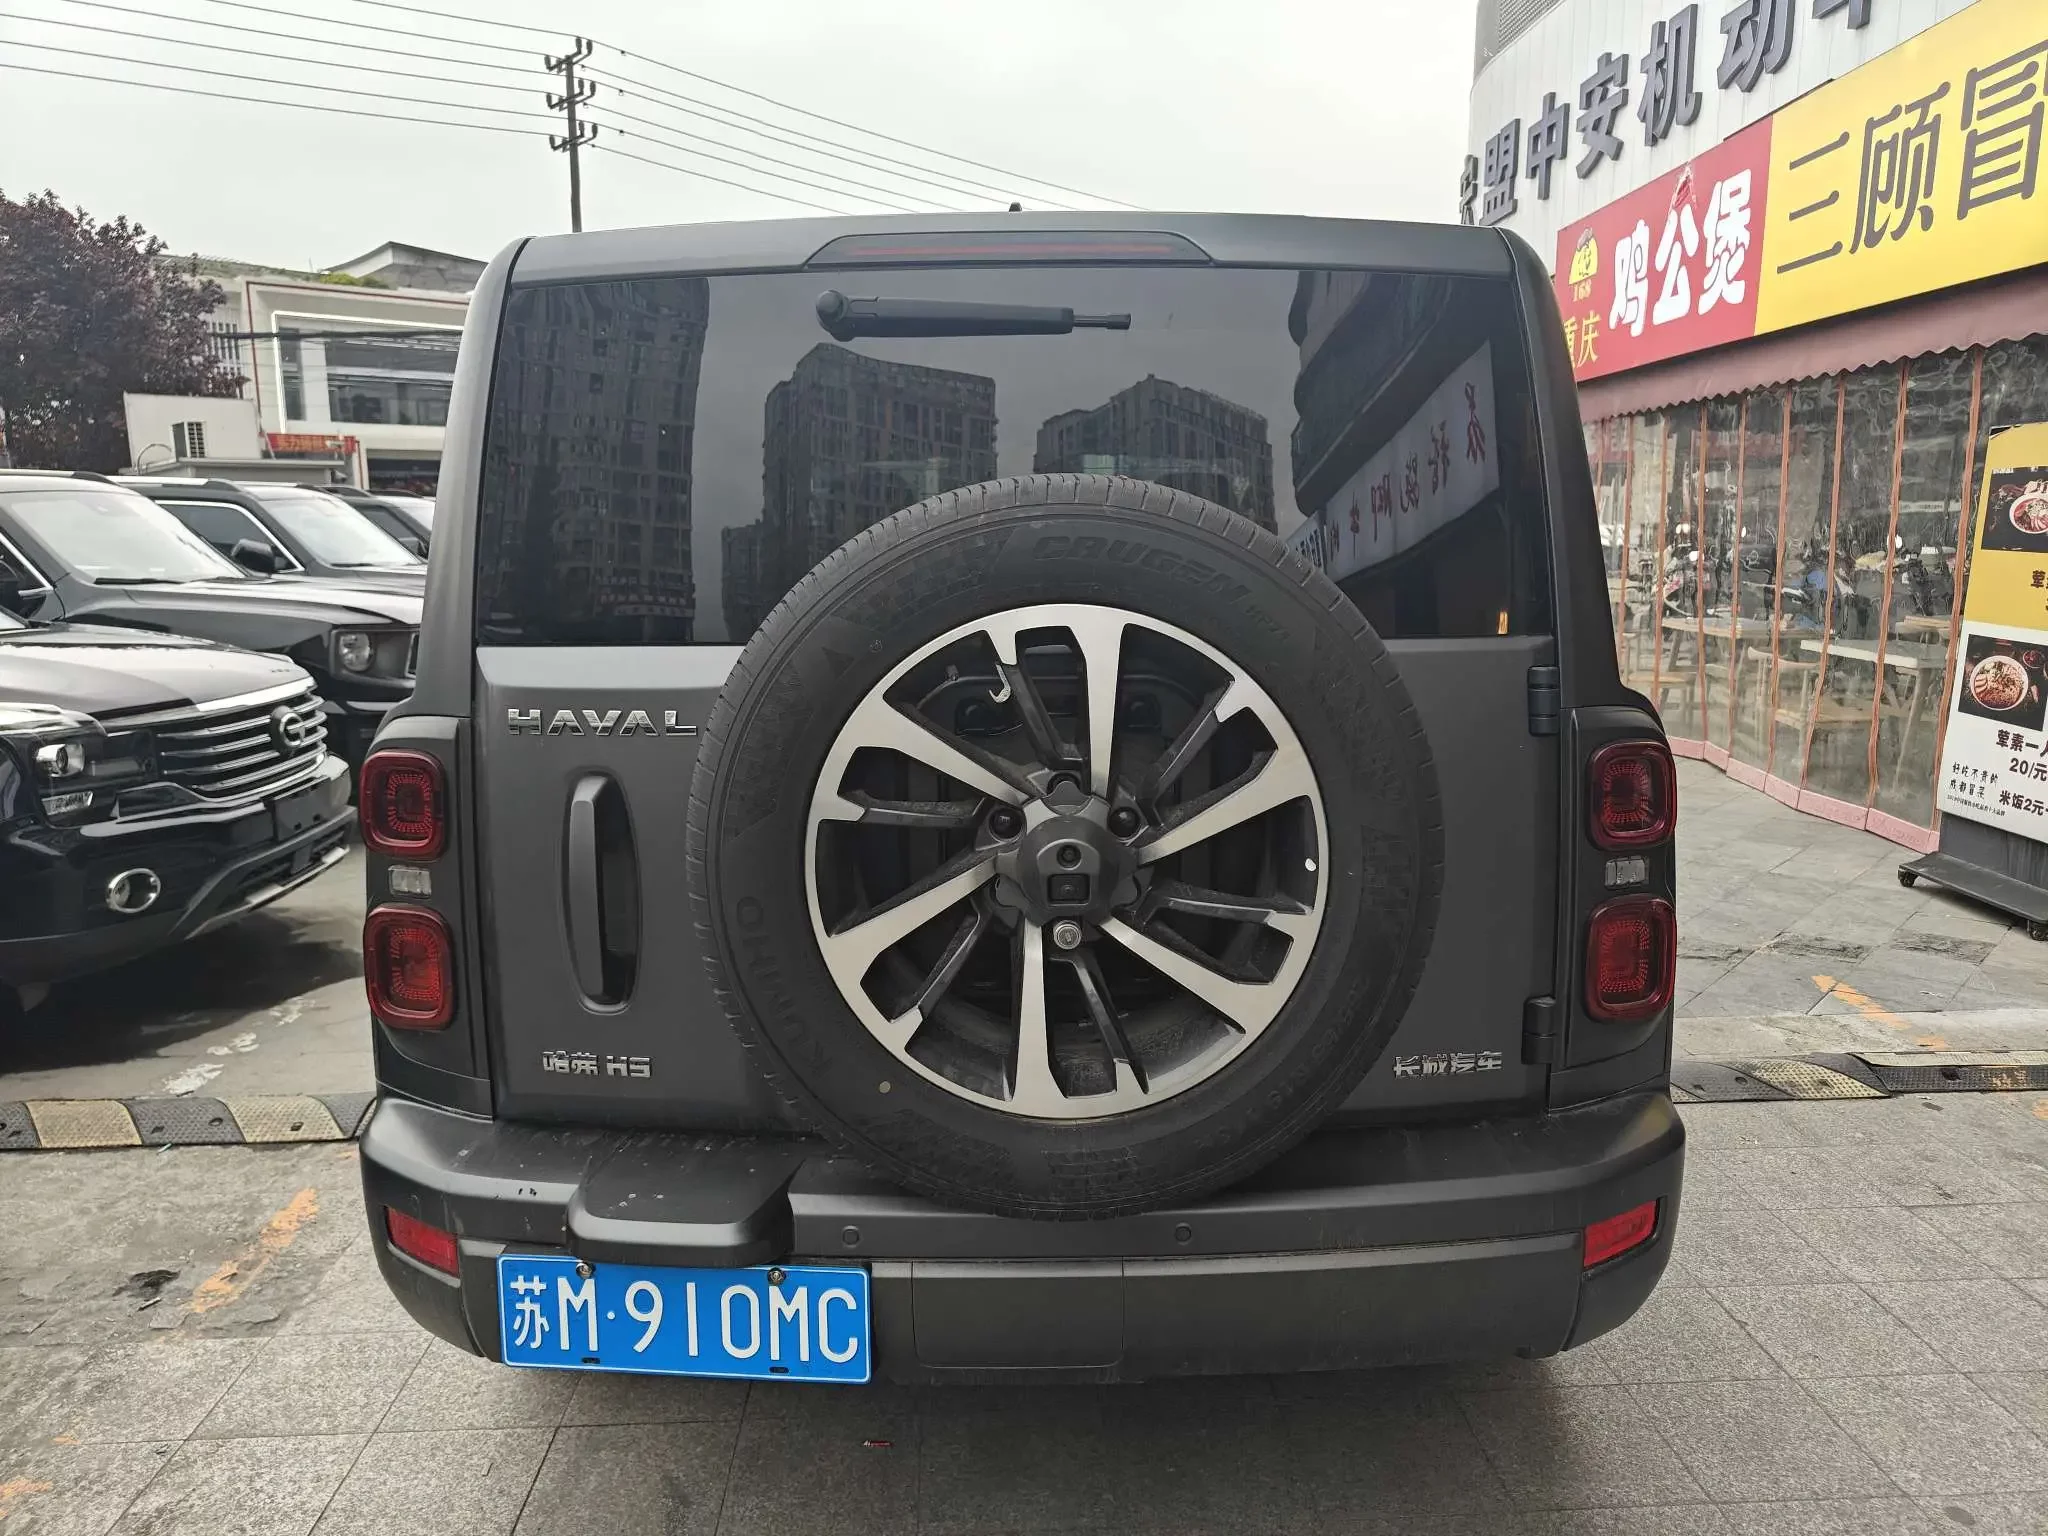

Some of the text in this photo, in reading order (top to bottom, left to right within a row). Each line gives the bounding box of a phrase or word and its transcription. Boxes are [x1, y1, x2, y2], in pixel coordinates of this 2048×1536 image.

[1459, 0, 1872, 226] 安盟中安机动
[1776, 40, 2048, 275] 三顾冒
[1608, 168, 1753, 337] 鸡公煲
[2031, 569, 2048, 589] 荤
[507, 707, 698, 736] HAVAL
[1999, 790, 2048, 816] 米饭2元
[606, 1055, 652, 1078] H5
[1393, 1050, 1503, 1078] 长城汽车
